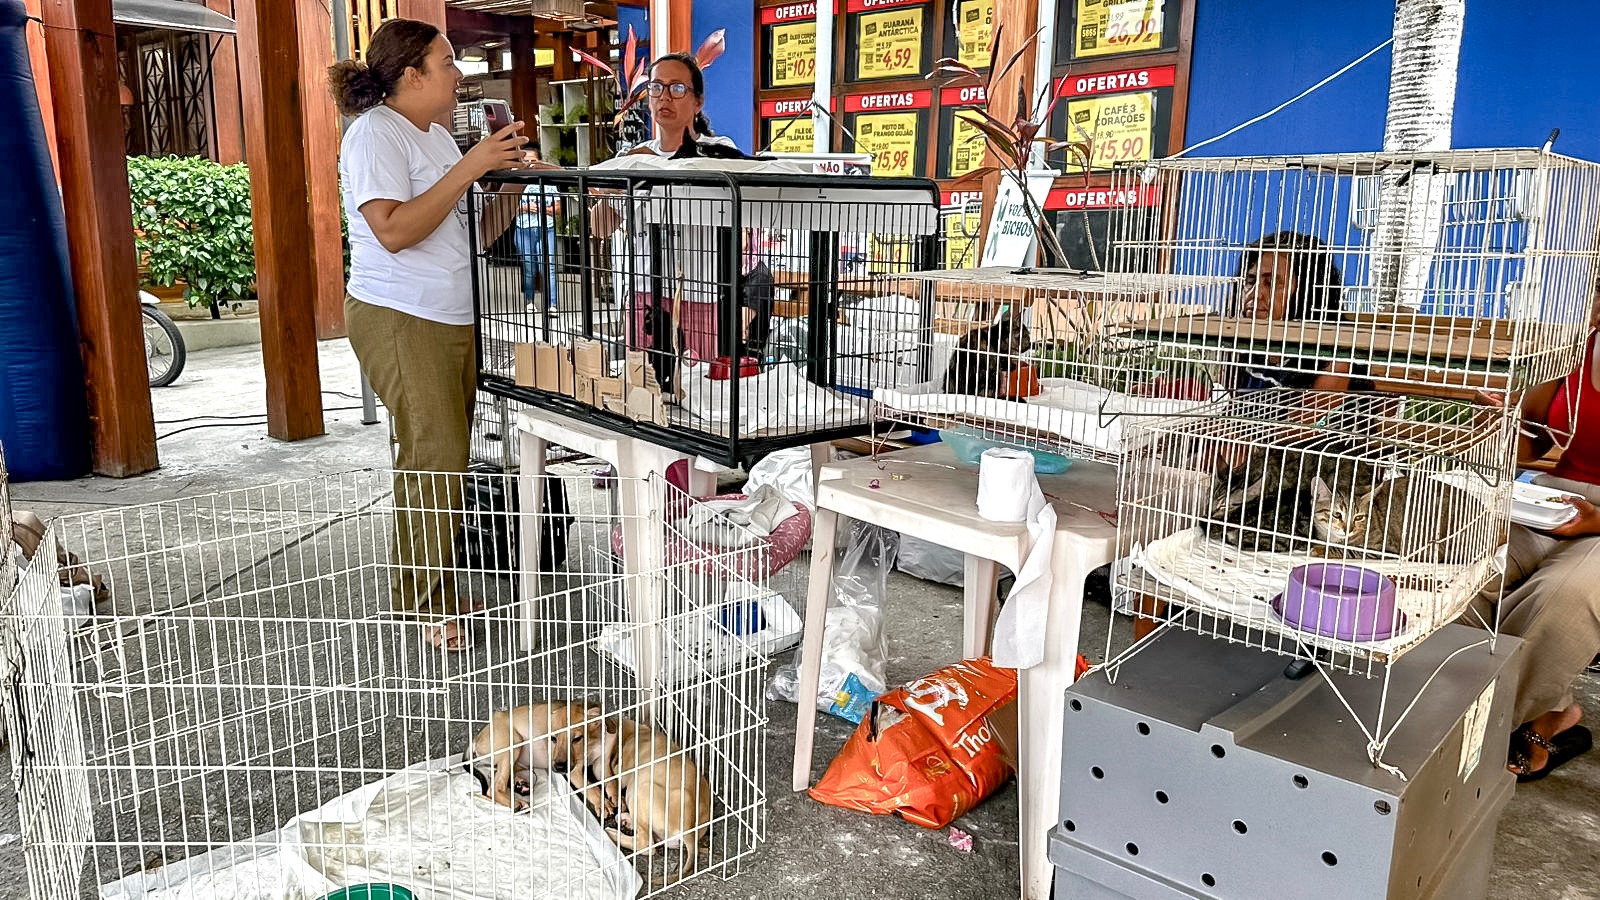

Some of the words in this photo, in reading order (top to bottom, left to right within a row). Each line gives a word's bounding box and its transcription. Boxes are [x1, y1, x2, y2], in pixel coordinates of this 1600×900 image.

[776, 3, 817, 19] OFERTA
[882, 17, 915, 29] GUARANÁ
[882, 48, 911, 70] 4,59
[793, 58, 815, 79] 10,9
[1076, 71, 1149, 93] OFERTAS
[861, 93, 914, 108] OFERTAS
[1104, 103, 1128, 116] CAFÉ
[1129, 104, 1136, 113] 3
[877, 150, 909, 171] 15,98
[1065, 190, 1137, 207] OFERTAS
[1001, 220, 1034, 237] BICHOS
